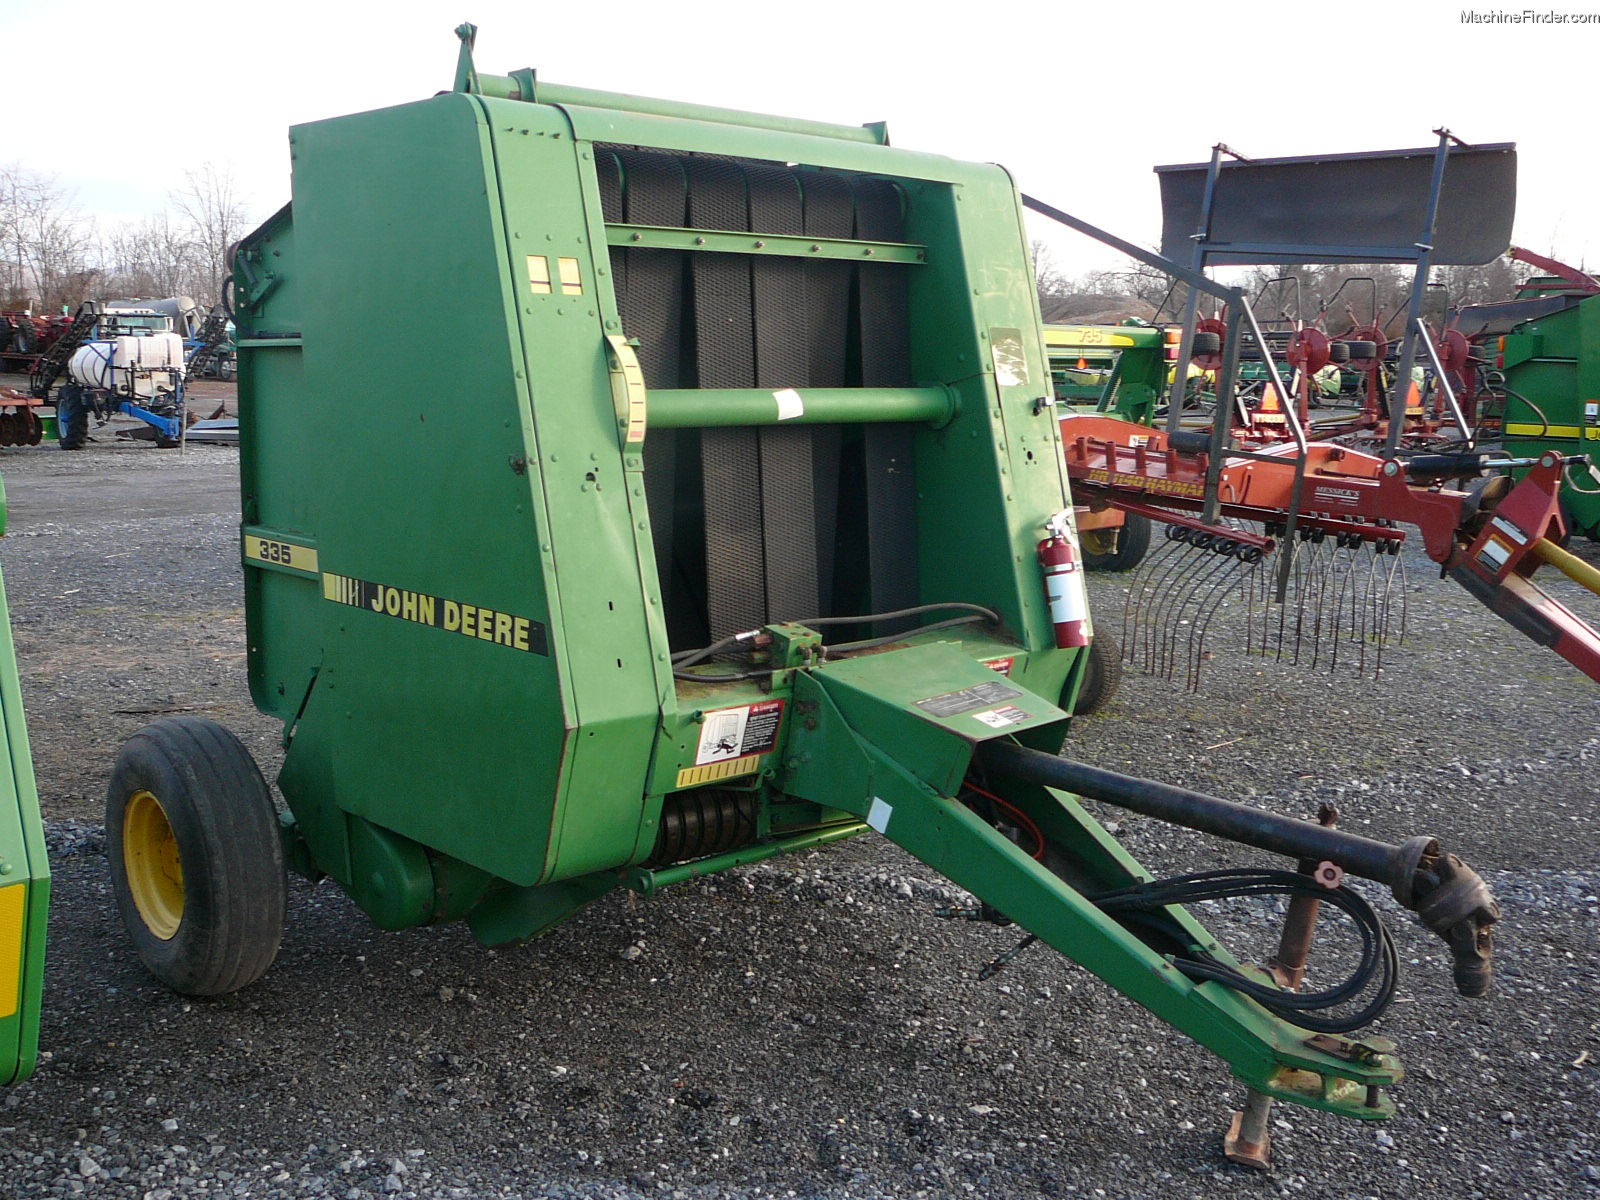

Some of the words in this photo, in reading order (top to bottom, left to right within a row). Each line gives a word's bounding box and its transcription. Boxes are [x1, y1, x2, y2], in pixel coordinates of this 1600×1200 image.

[259, 540, 292, 564] 335
[371, 584, 435, 627] JOHN
[443, 600, 530, 651] DEERE
